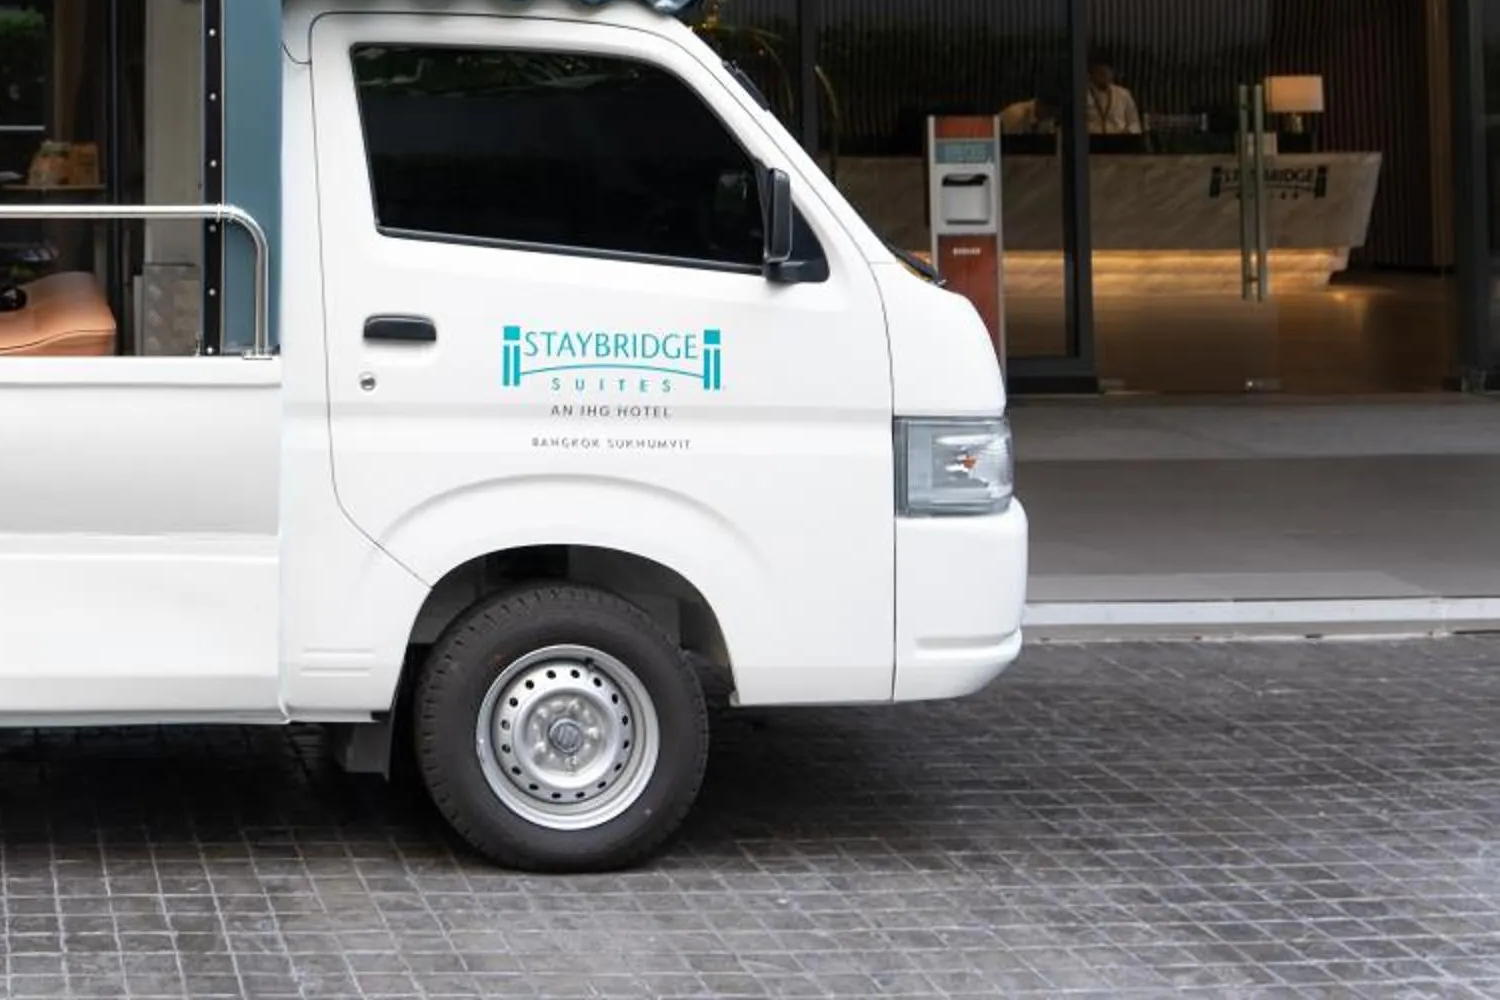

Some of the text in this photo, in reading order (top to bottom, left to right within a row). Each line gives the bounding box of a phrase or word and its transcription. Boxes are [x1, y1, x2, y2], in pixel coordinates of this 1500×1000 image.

[523, 330, 699, 359] STAYBRIDGE
[550, 377, 672, 393] SUITES
[550, 404, 672, 419] AN IHG HOTEL
[531, 437, 692, 450] BANGKOK SUKHUMVIT
